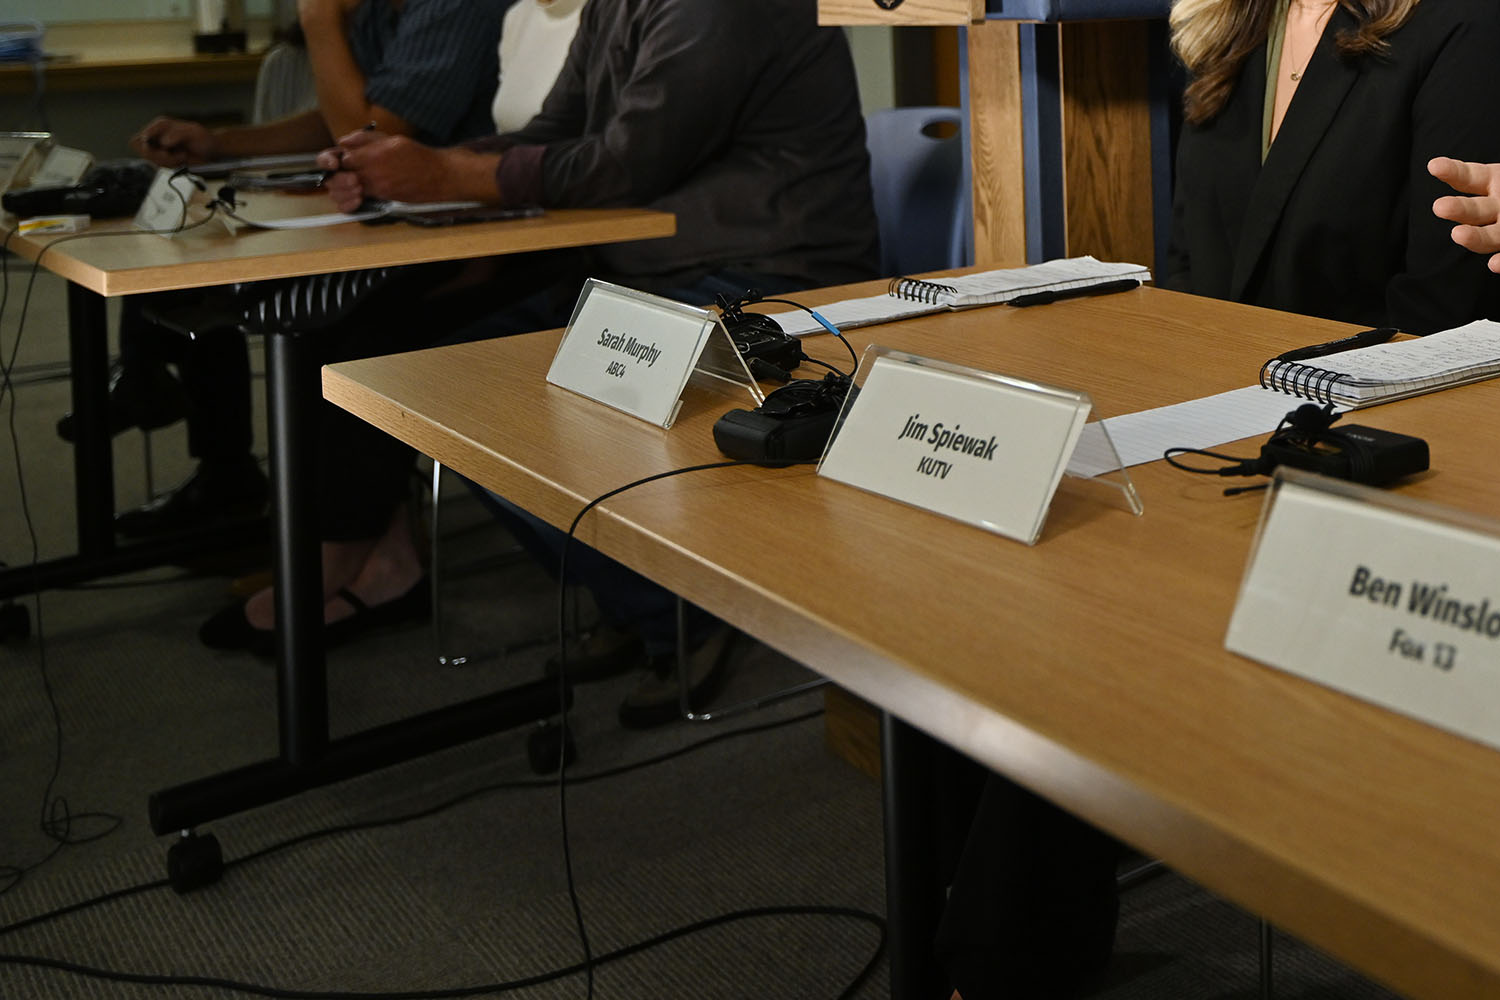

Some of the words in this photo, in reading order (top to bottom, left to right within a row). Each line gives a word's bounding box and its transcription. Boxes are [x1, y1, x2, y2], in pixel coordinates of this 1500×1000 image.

[597, 328, 626, 352] Sarah
[622, 336, 662, 368] Murphy
[605, 360, 627, 378] ABC4
[898, 413, 928, 441] Jim
[927, 422, 998, 461] Spiewak
[916, 456, 953, 479] KUTV
[1349, 565, 1403, 609] Ben
[1388, 627, 1426, 664] Fox
